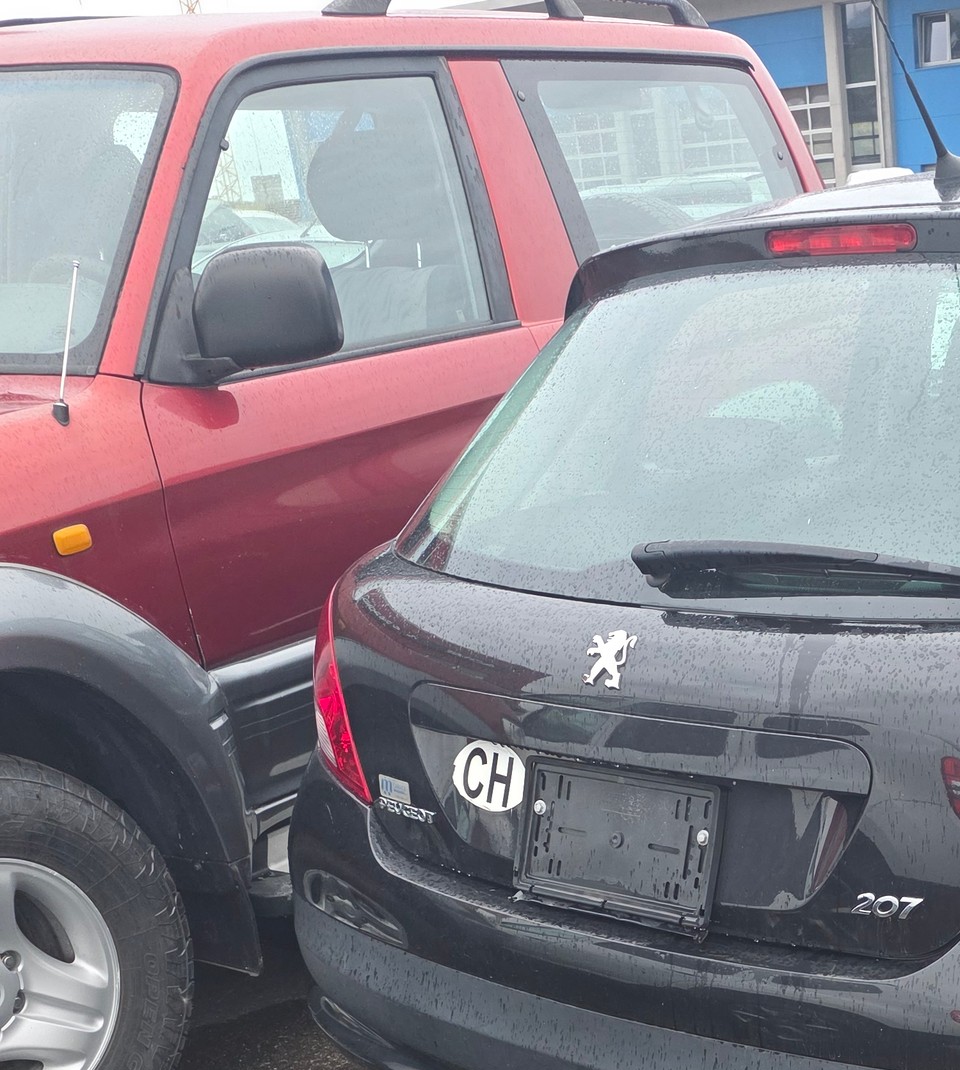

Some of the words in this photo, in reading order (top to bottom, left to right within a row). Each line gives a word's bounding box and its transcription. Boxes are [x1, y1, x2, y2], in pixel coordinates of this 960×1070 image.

[463, 747, 514, 808] CH
[379, 796, 436, 824] PEUGEOT
[851, 892, 924, 919] 207
[137, 952, 161, 1049] OPEN
